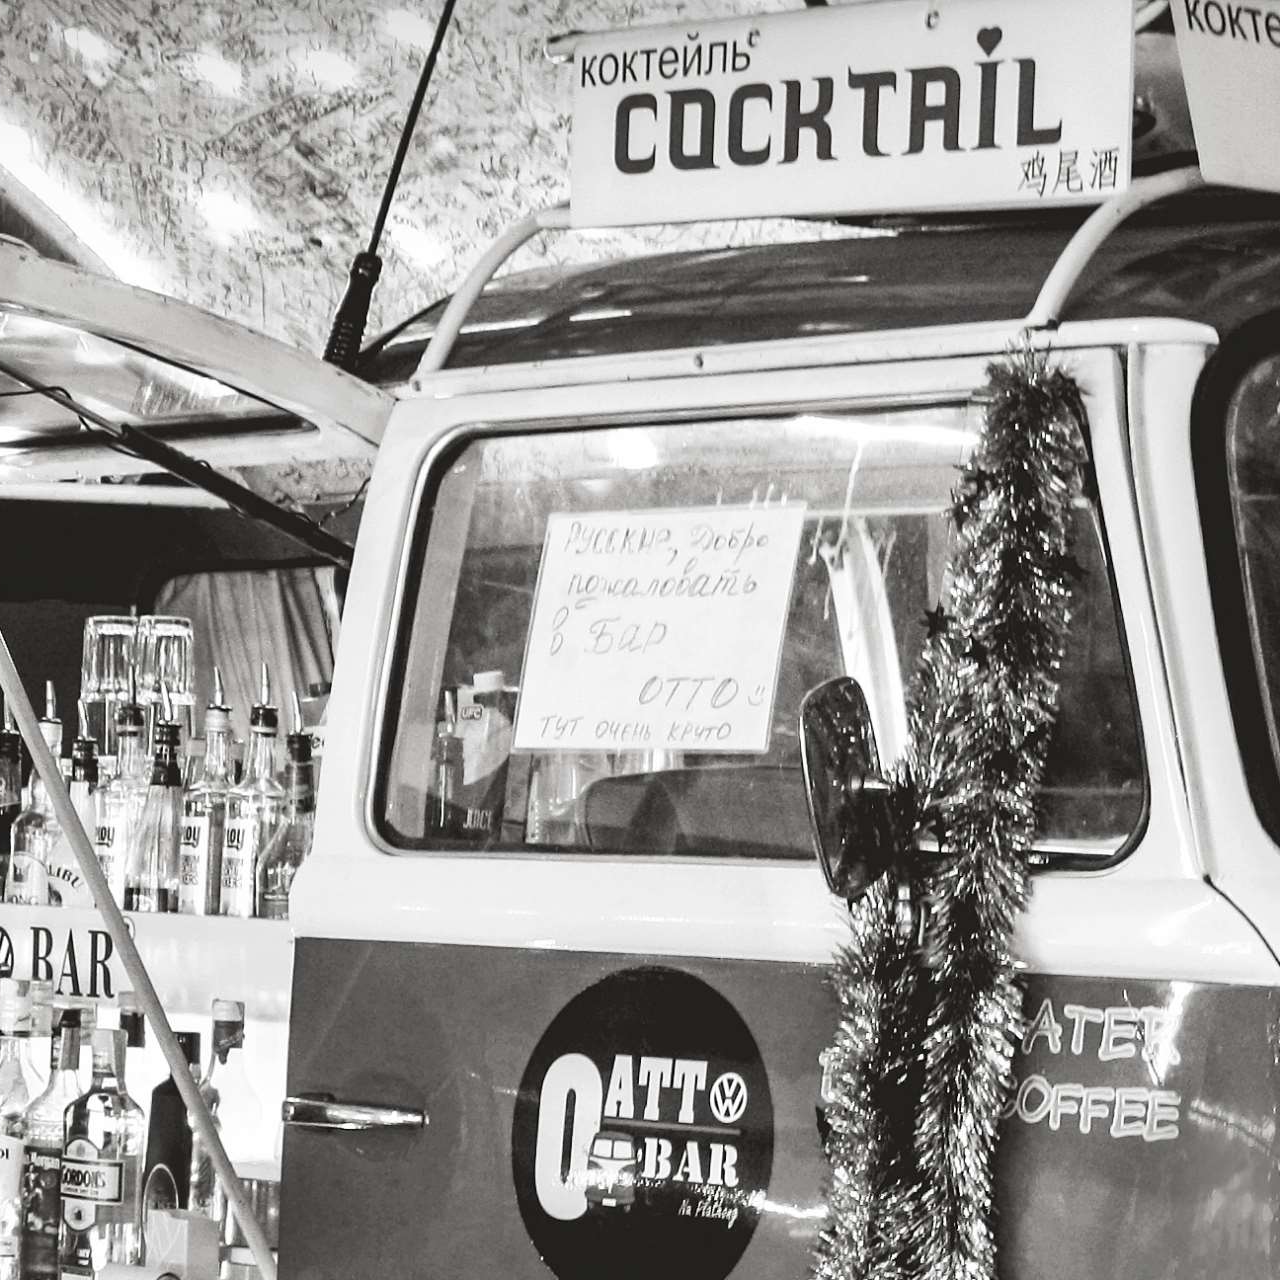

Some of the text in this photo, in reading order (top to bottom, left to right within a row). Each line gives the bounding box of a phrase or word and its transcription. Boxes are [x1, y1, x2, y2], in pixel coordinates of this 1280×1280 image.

[613, 56, 1063, 175] COCKTAIL
[1018, 146, 1119, 197] 鸡尾酒
[30, 926, 115, 999] BAR
[1021, 998, 1182, 1066] ATER
[641, 1137, 739, 1188] BAR
